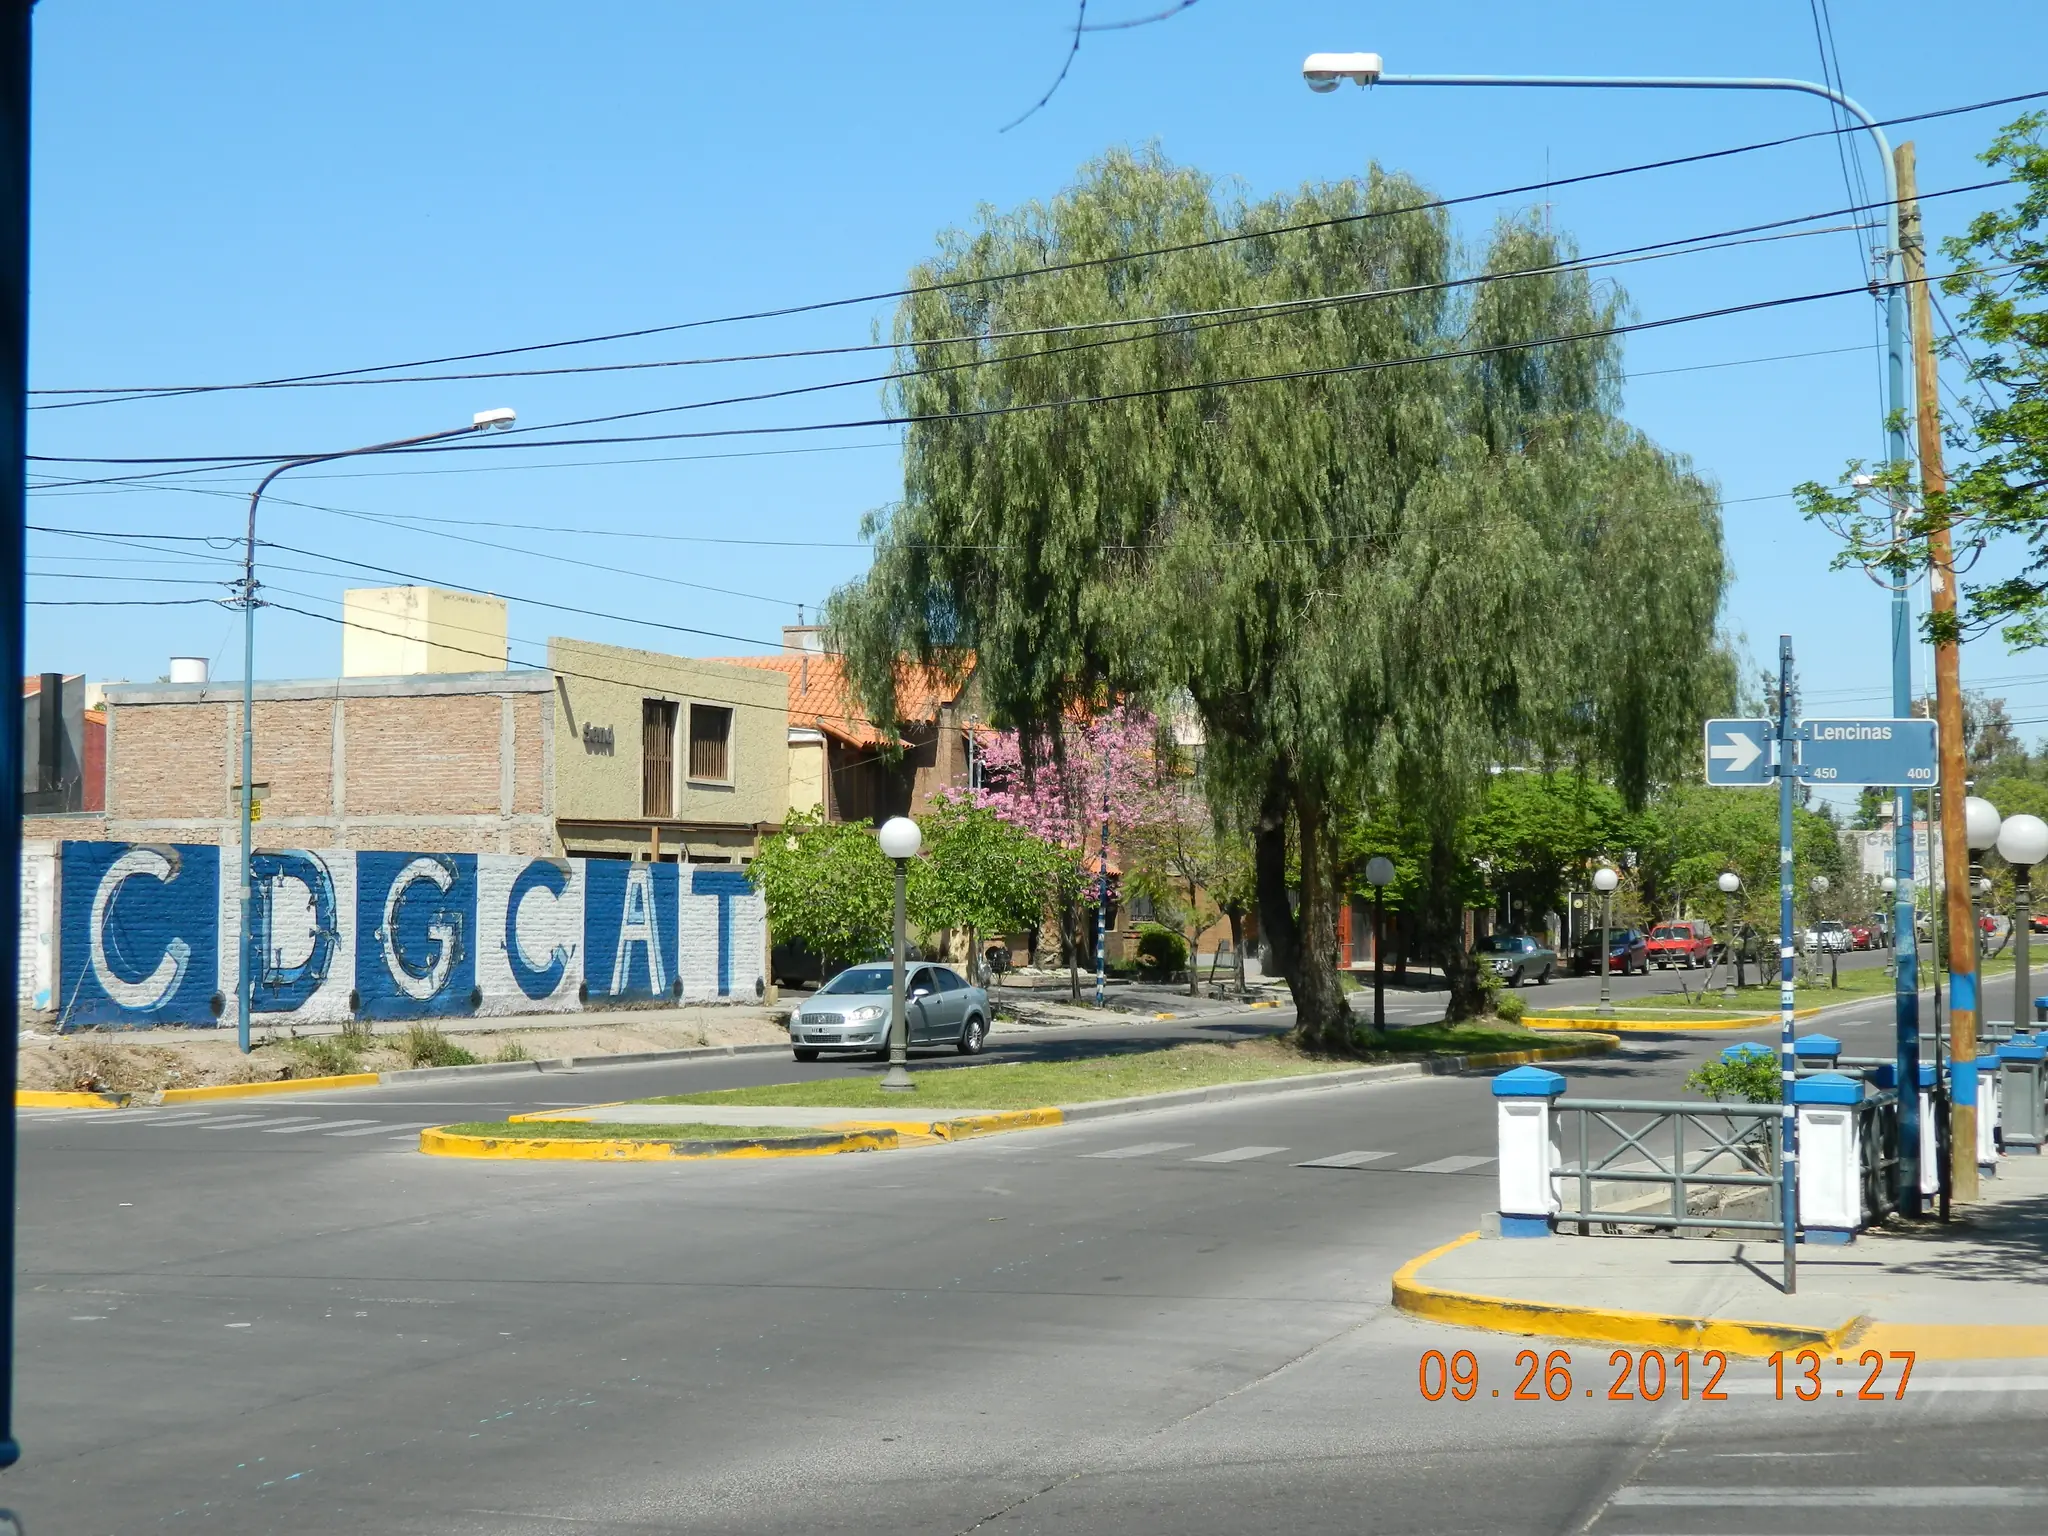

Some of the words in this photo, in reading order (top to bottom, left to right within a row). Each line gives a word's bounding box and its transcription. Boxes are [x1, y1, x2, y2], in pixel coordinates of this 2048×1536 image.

[1813, 723, 1892, 740] Lencinas
[1813, 767, 1838, 779] 450
[1907, 767, 1931, 779] 400
